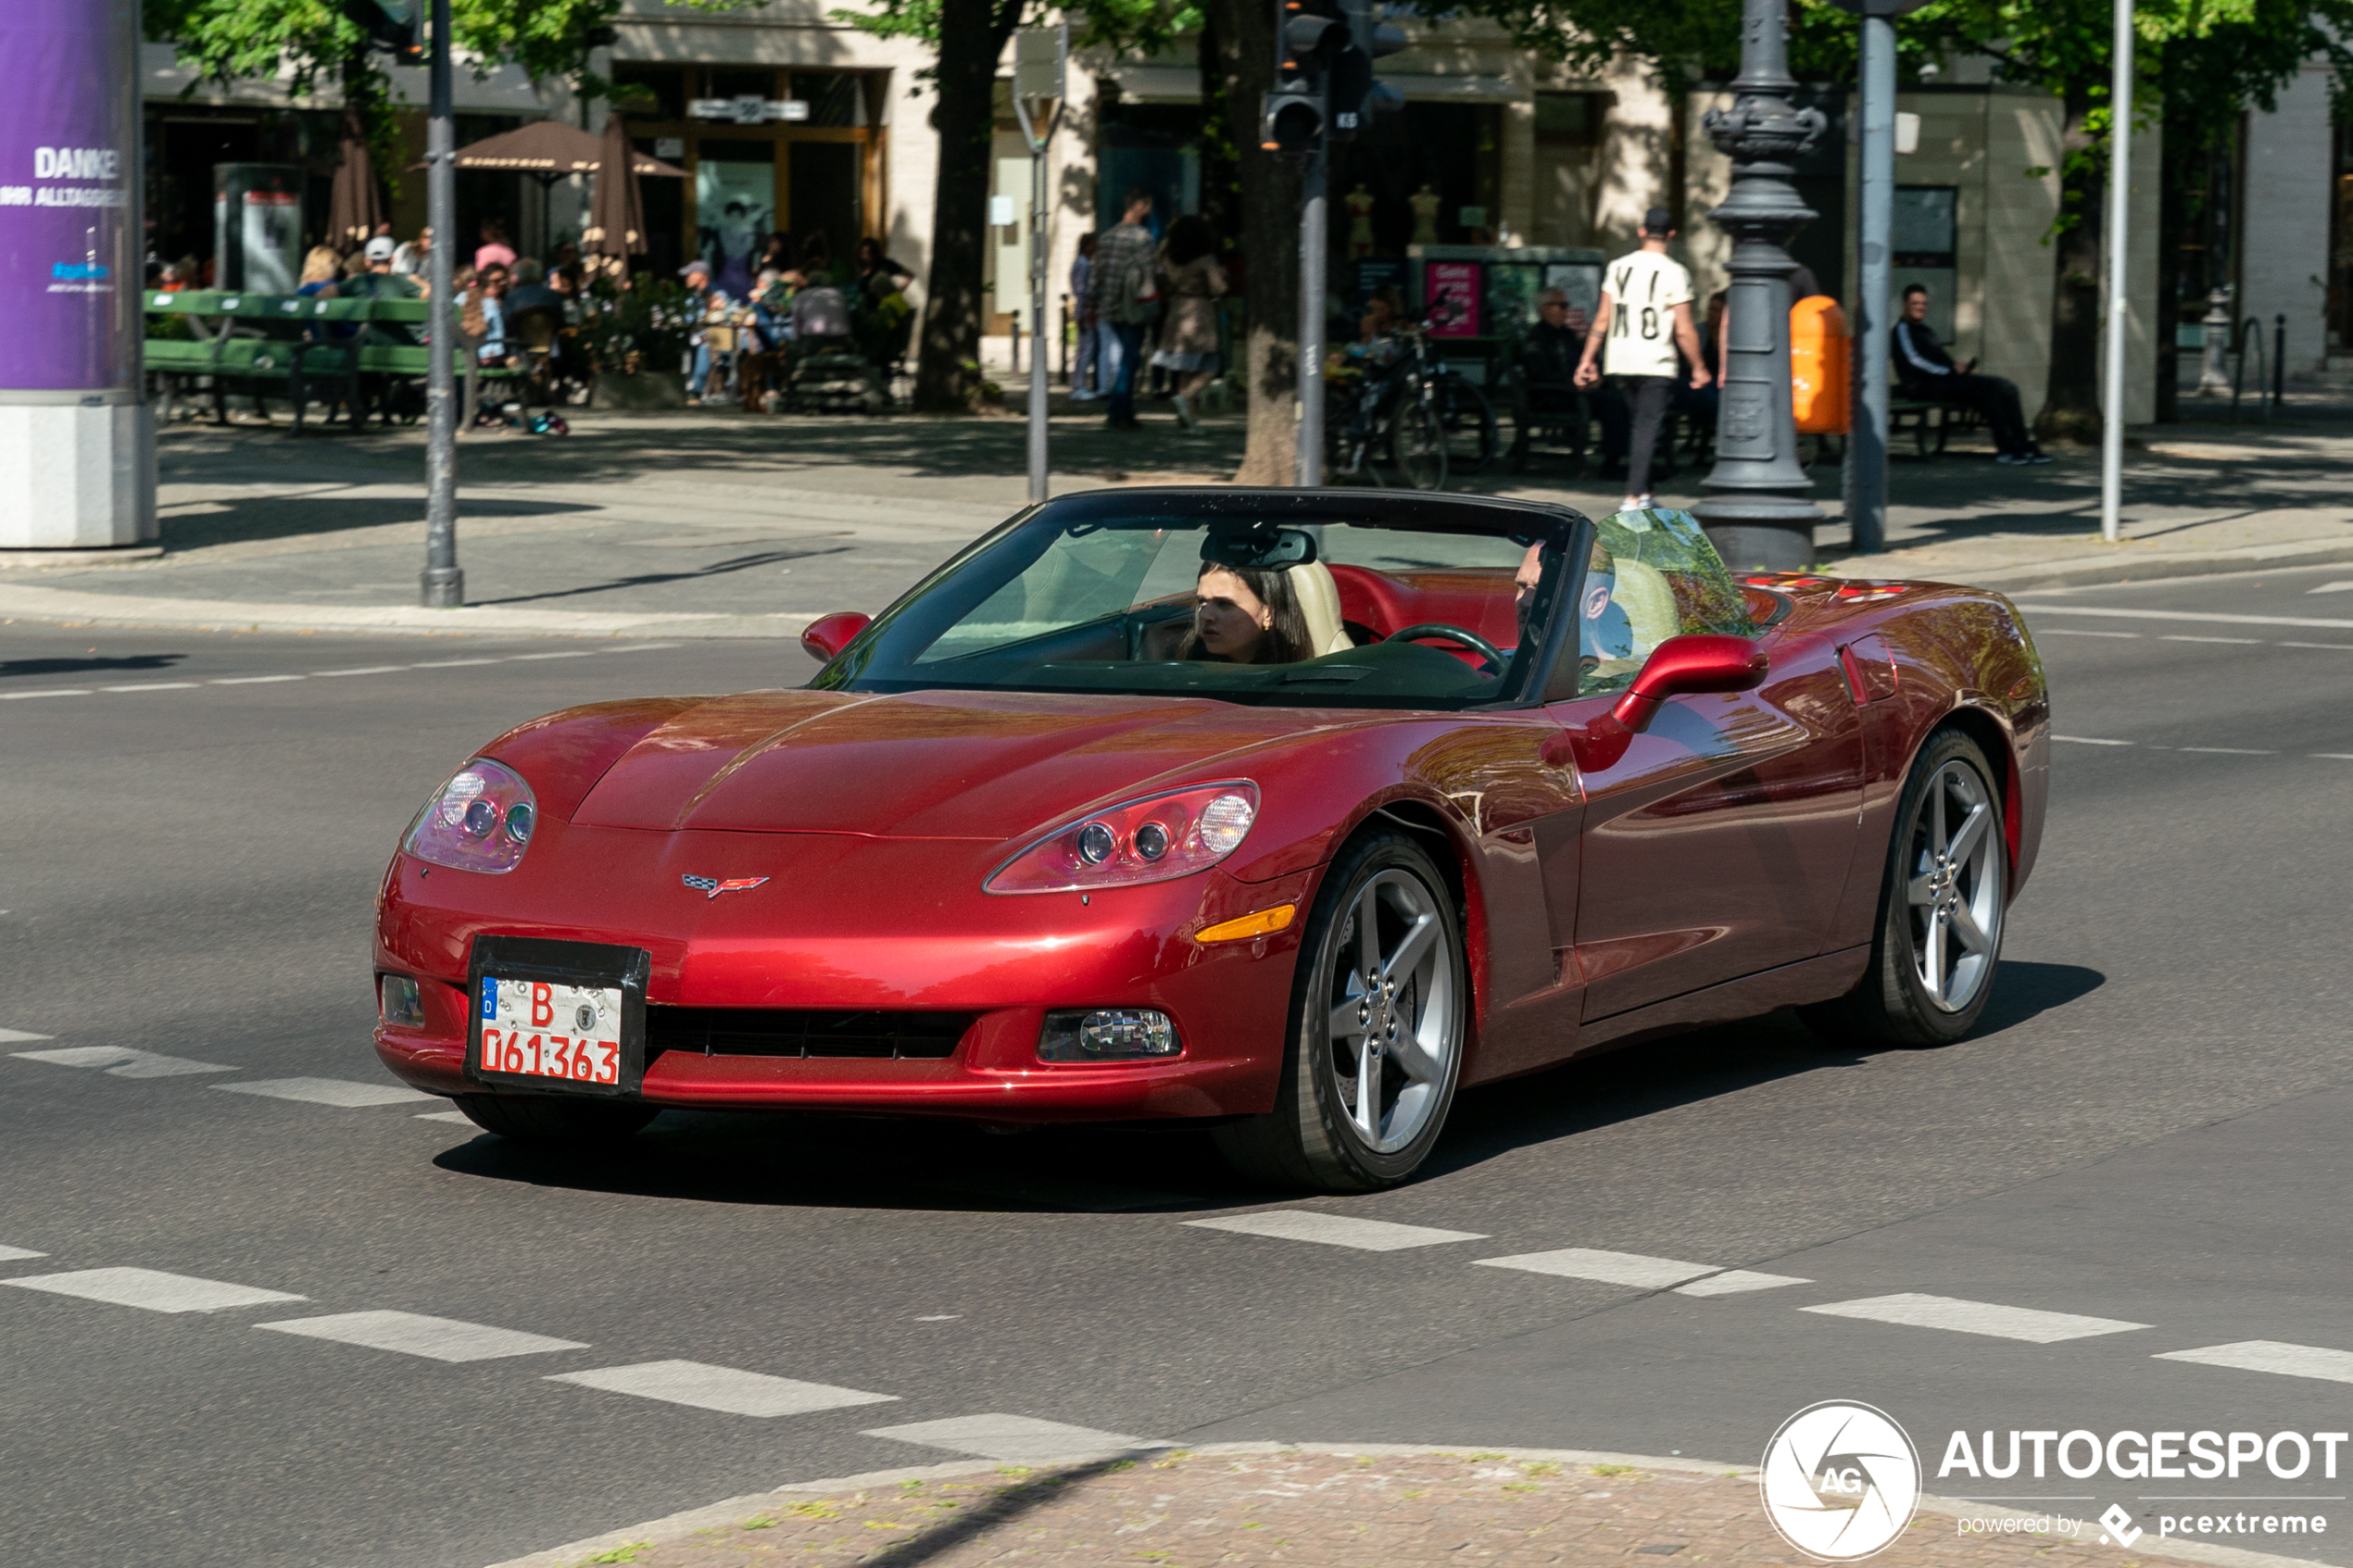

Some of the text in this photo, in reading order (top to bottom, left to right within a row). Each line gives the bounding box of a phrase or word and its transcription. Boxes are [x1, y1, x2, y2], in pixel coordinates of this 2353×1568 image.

[34, 146, 120, 180] DANKE
[484, 999, 493, 1013] D
[532, 982, 555, 1027] B
[481, 1028, 619, 1085] 061363
